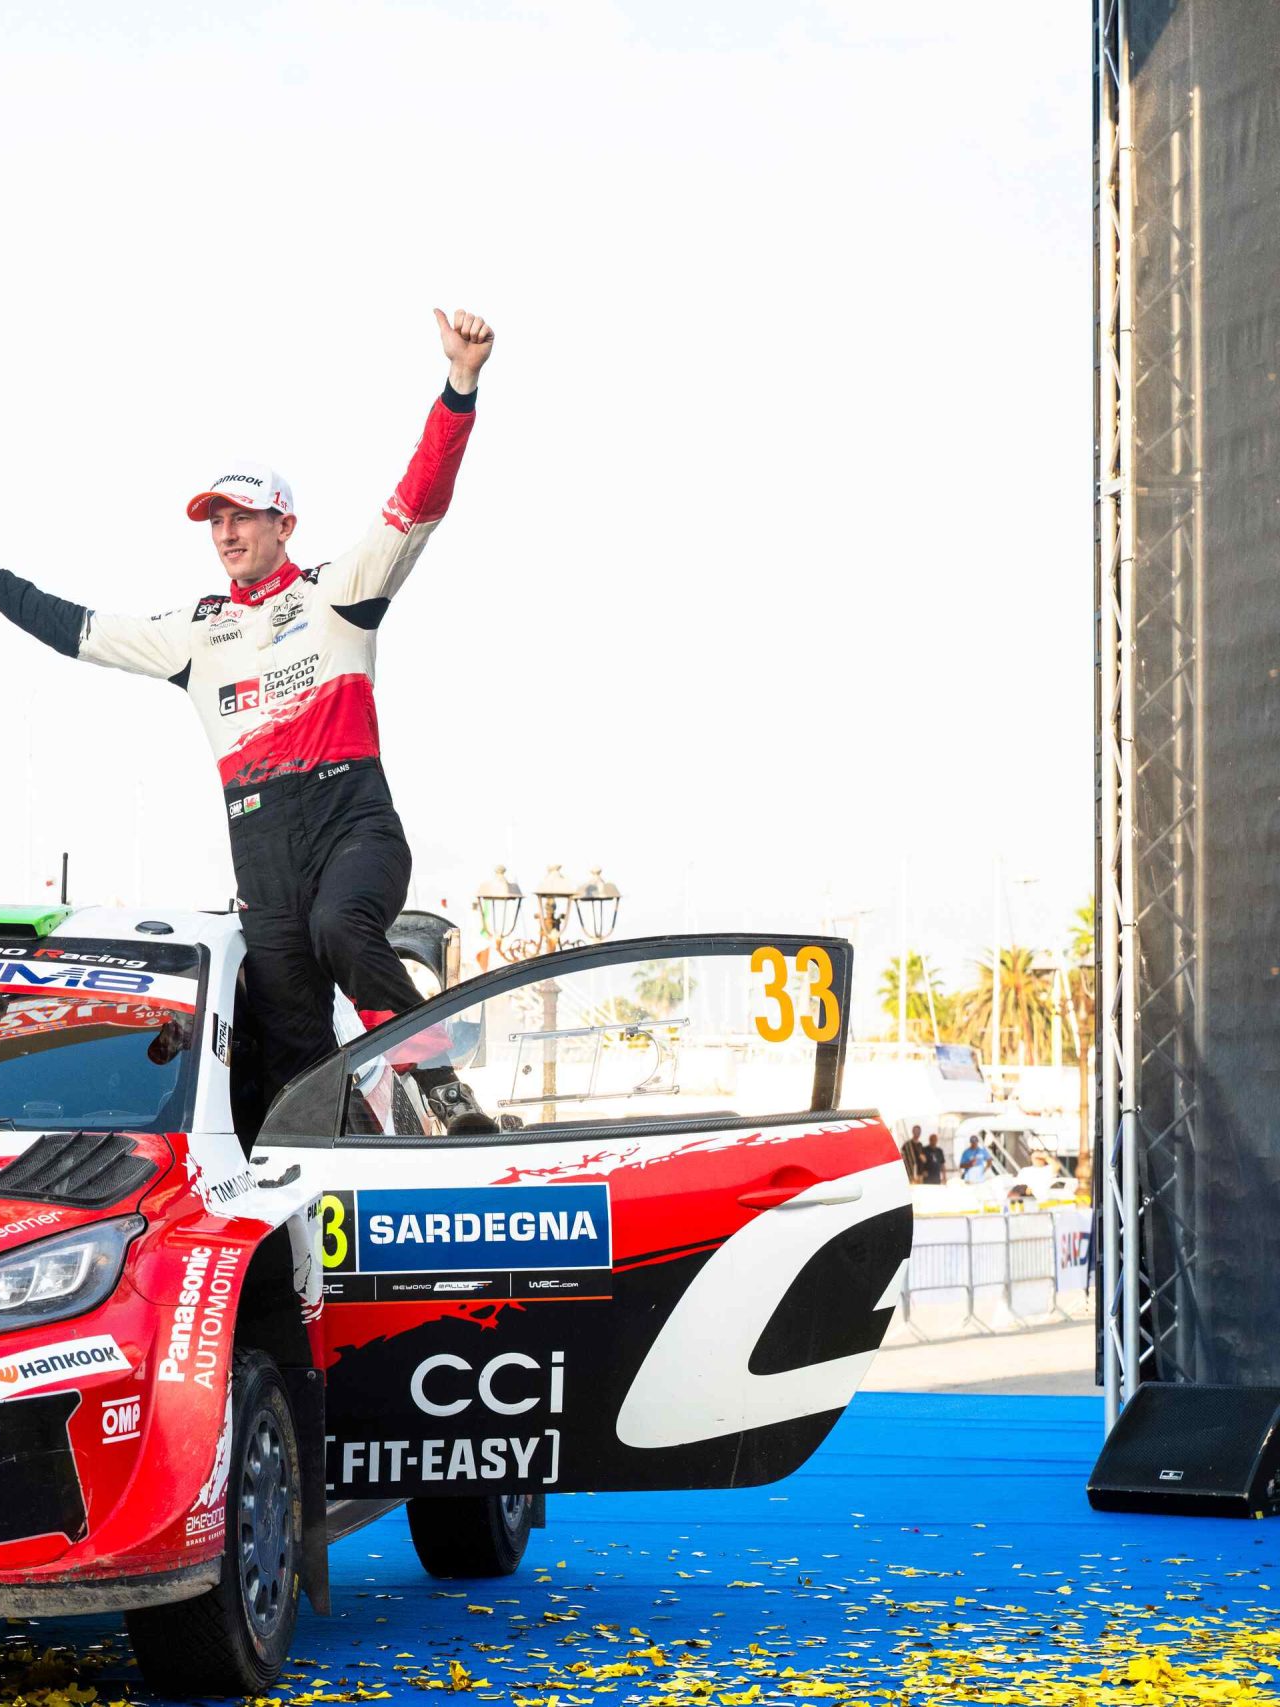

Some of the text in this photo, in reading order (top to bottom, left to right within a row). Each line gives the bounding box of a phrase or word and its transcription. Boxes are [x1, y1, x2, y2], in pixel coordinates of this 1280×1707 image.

[273, 491, 288, 511] 1st
[263, 653, 320, 682] TOYOTA
[264, 665, 315, 693] GAZOO
[220, 691, 259, 716] GR
[264, 676, 315, 704] Racing
[318, 763, 350, 780] E. EVANS
[229, 802, 243, 816] OMP
[33, 949, 148, 969] Racing
[750, 945, 841, 1043] 33
[218, 1020, 228, 1064] CENTRAL
[211, 1170, 257, 1204] TAMADIC
[369, 1210, 598, 1245] SARDEGNA
[158, 1246, 213, 1383] Panasonic
[193, 1246, 242, 1390] AUTOMOTIVE
[410, 1350, 565, 1417] CCi
[102, 1402, 141, 1436] OMP
[185, 1536, 206, 1547] BRAKE
